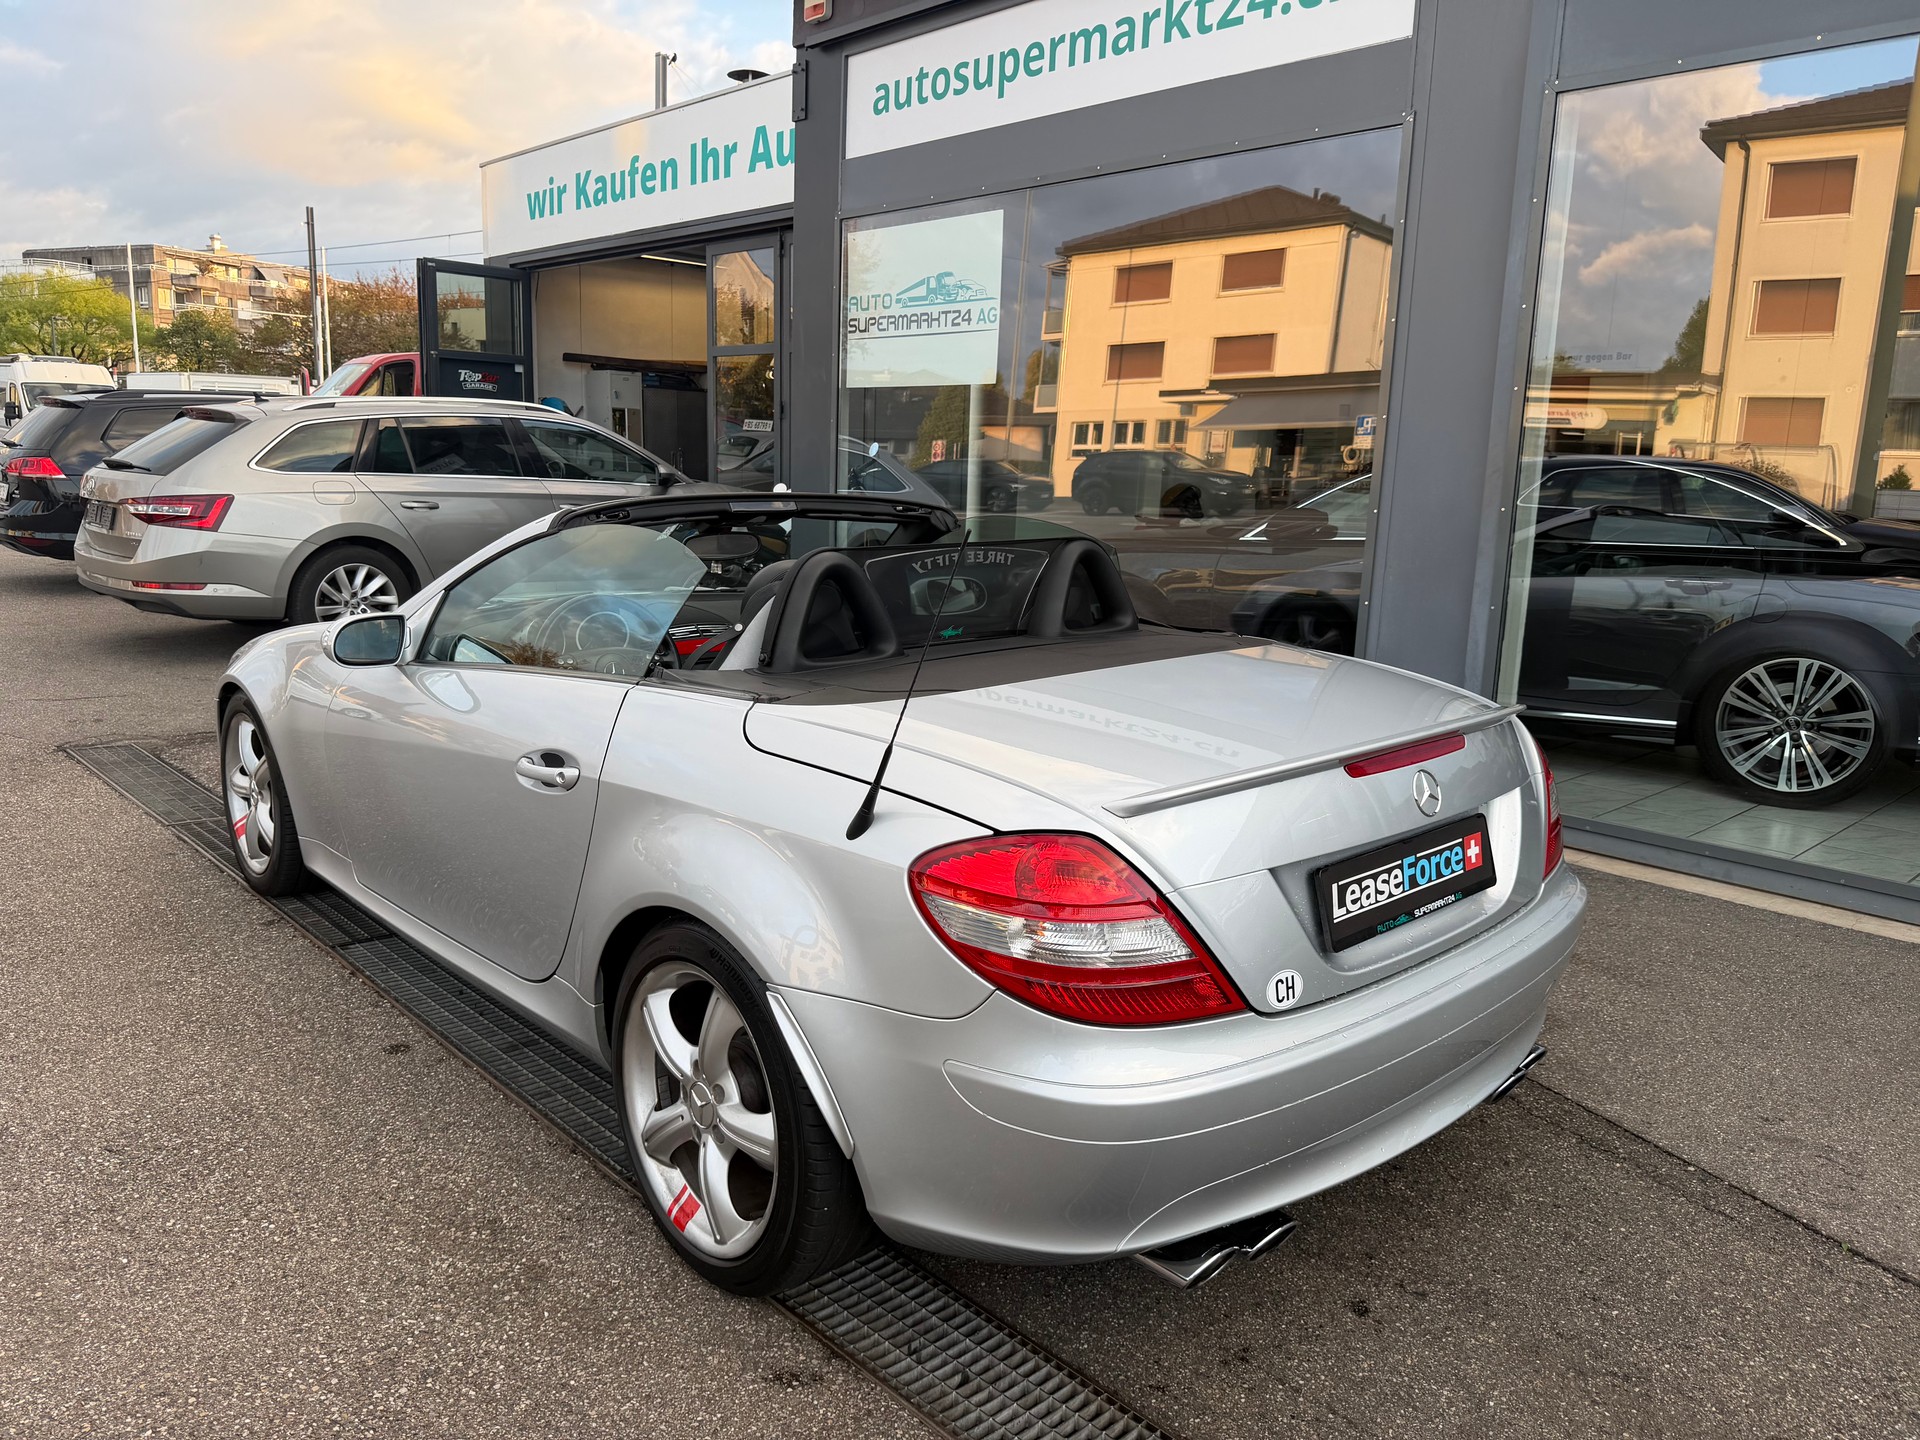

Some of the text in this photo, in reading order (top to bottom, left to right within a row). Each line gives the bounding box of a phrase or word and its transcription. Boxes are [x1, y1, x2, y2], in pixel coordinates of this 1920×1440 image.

[526, 176, 567, 220] wir
[575, 155, 678, 211] Kaufen
[690, 136, 738, 185] Ihr
[848, 293, 893, 312] AUTO
[848, 306, 998, 334] SUPERMARKT24 AG
[1585, 354, 1613, 363] gegen
[1616, 352, 1632, 360] Bar
[1331, 844, 1464, 919] LeaseForce
[1376, 920, 1395, 934] AUTO
[1456, 891, 1463, 901] AG
[1275, 973, 1296, 1003] CH
